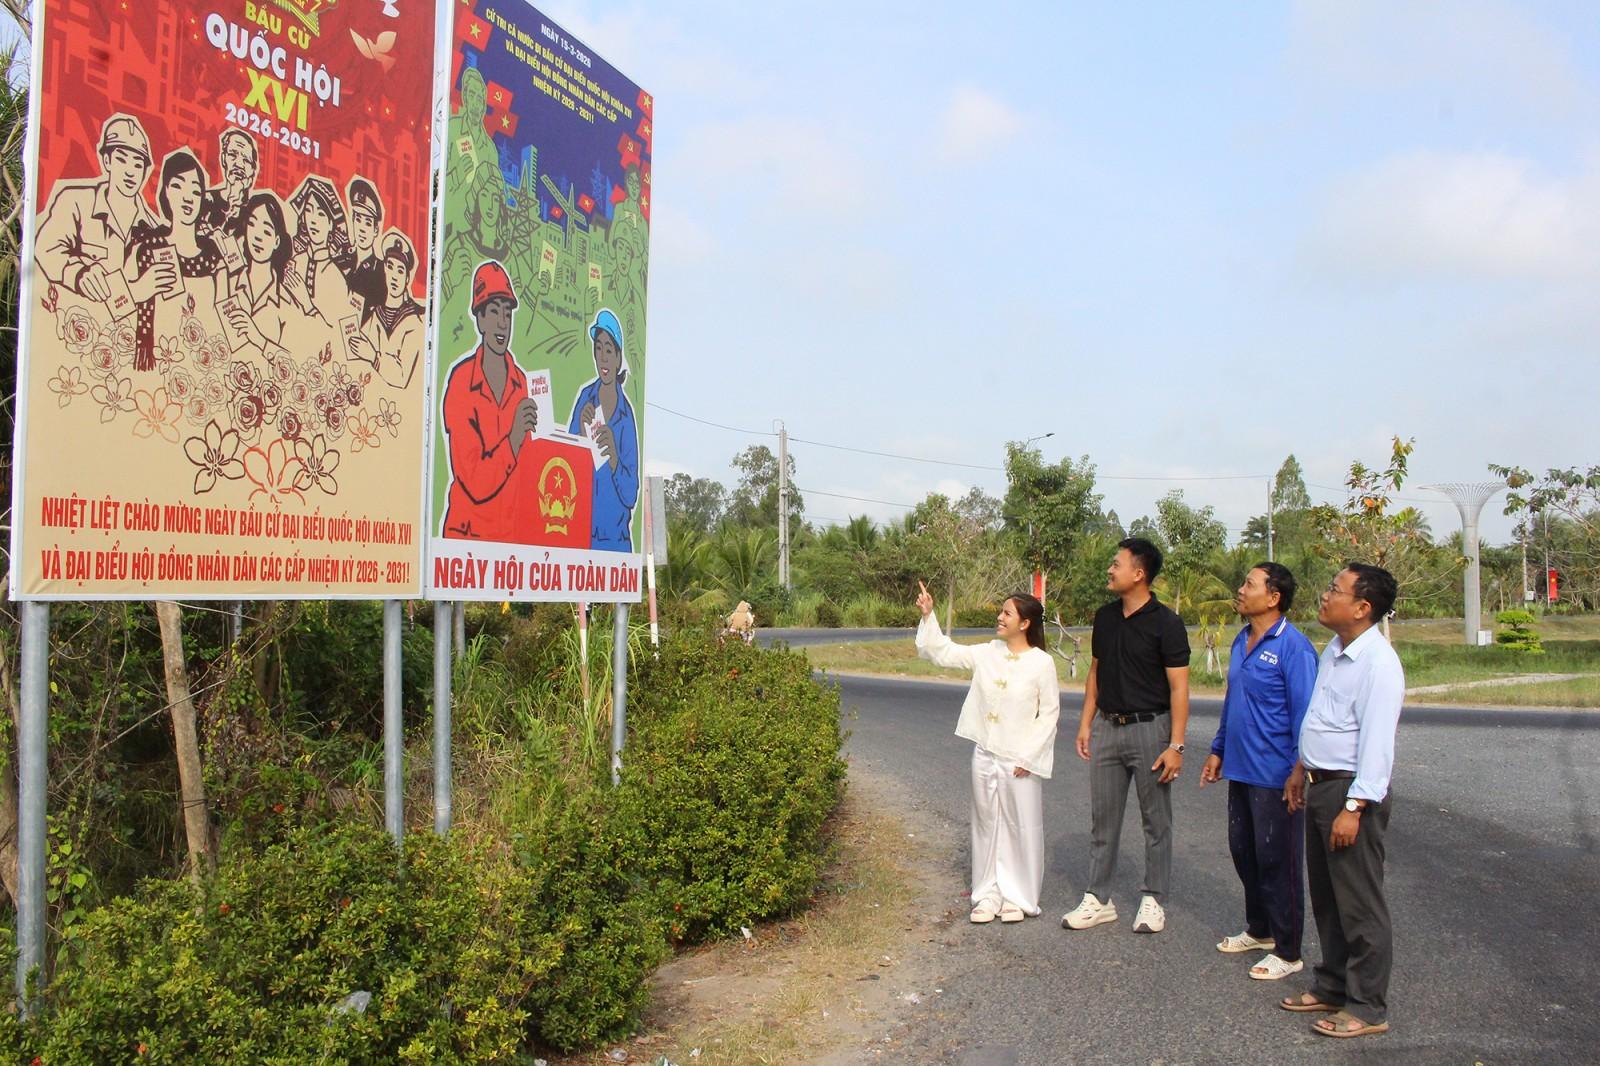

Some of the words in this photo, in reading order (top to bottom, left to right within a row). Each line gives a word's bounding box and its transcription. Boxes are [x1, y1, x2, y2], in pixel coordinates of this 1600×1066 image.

[245, 1, 282, 35] BẦU
[541, 23, 559, 44] NGÀY
[205, 13, 287, 80] QUỐC
[295, 56, 341, 107] HỘI
[243, 67, 309, 131] XVI
[224, 102, 321, 159] 2026-2031
[41, 491, 87, 535] NHIỆT
[90, 494, 120, 536] LIỆT
[123, 497, 160, 532] CHÀO
[163, 500, 201, 535] MỪNG
[204, 503, 237, 536] NGÀY
[239, 502, 263, 537] BẦU
[265, 504, 281, 538] CỬ
[283, 513, 300, 544] ĐẠI
[302, 505, 325, 541] BIỂU
[328, 510, 353, 544] QUỐC
[355, 515, 371, 548] HỘI
[372, 517, 396, 545] KHÓA
[398, 522, 412, 546] XVI
[41, 543, 61, 580] VÀ
[65, 550, 91, 587] ĐẠI
[95, 539, 128, 580] BIỂU
[131, 546, 155, 587] HỘI
[158, 543, 193, 581] ĐỒNG
[196, 549, 230, 581] NHÂN
[233, 550, 257, 582] DÂN
[260, 551, 282, 582] CÁC
[284, 548, 306, 582] CẤP
[307, 553, 340, 588] NHIỆM
[341, 554, 355, 583] KỲ
[356, 560, 379, 584] 2026
[386, 561, 410, 584] 2031!
[434, 551, 488, 590] NGÀY
[493, 555, 524, 597] HỘI
[529, 551, 562, 591] CỦA
[567, 559, 606, 592] TOÀN
[609, 562, 639, 593] DÂN
